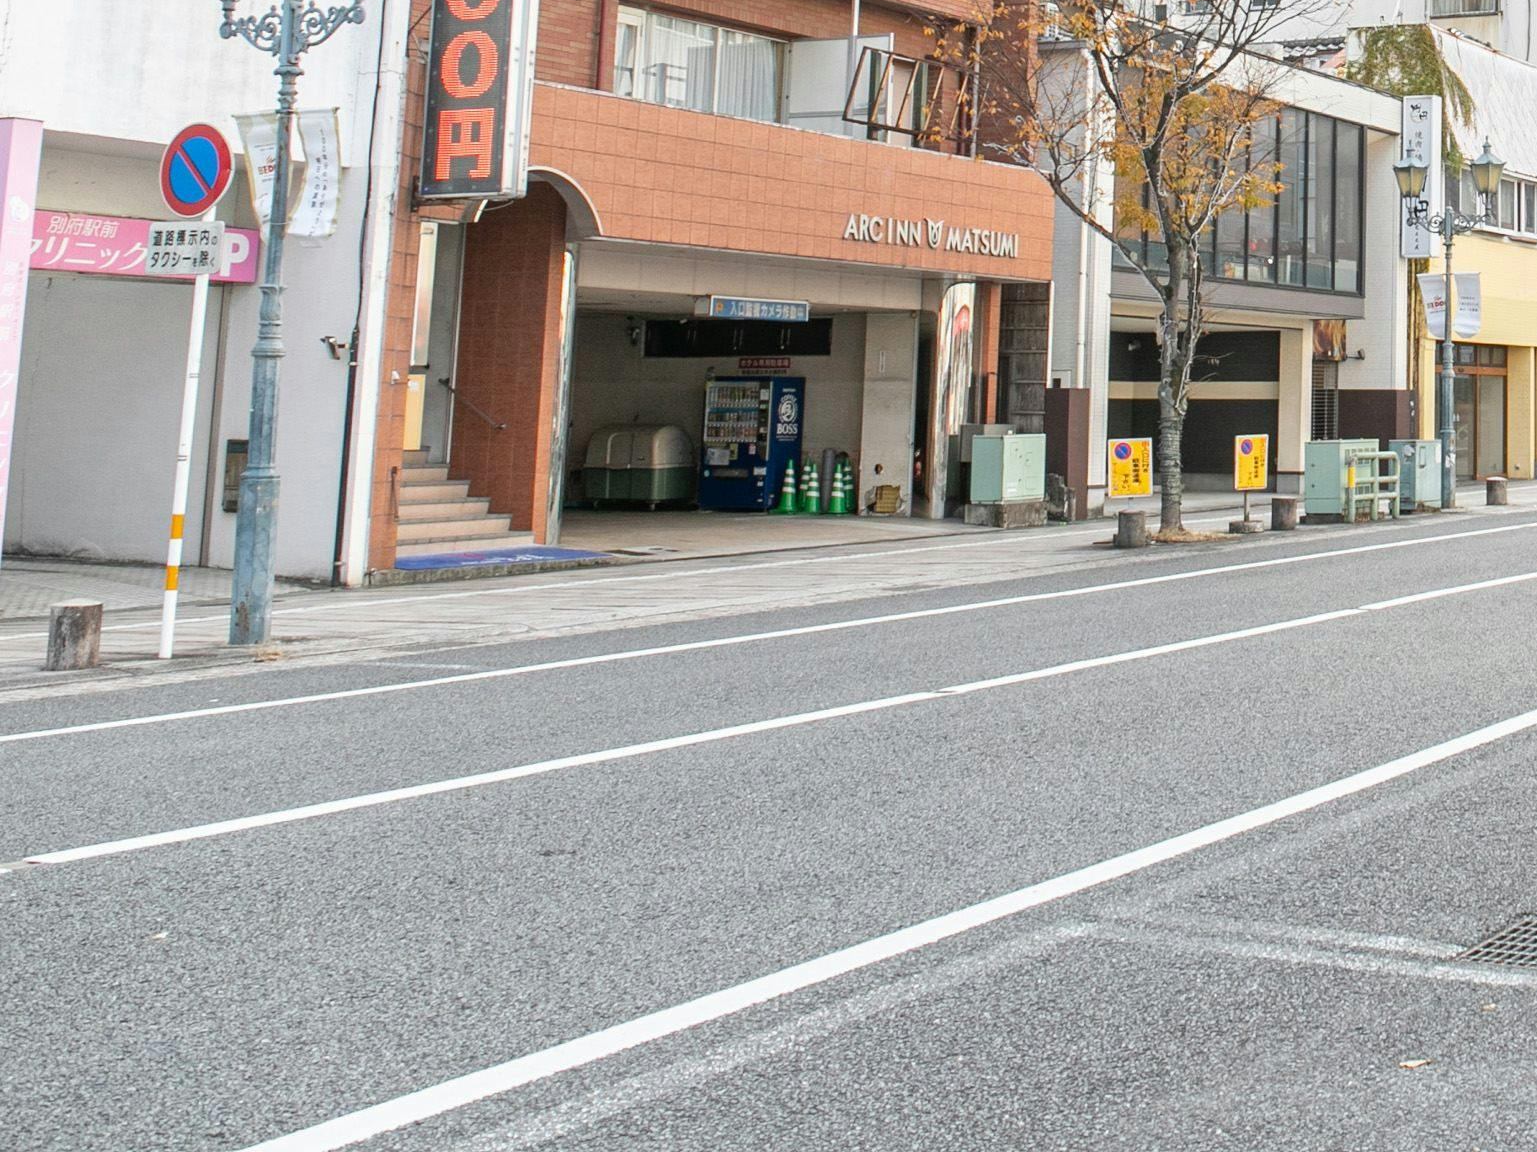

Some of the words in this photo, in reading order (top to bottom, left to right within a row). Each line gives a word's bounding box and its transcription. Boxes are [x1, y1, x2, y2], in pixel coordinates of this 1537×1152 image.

[46, 215, 121, 239] 別府駅前
[844, 214, 884, 242] ARC
[887, 217, 922, 246] INN
[945, 227, 1019, 258] MATSUMI
[152, 229, 218, 247] 道路標示内の
[150, 250, 217, 268] タクシーを除く
[219, 232, 250, 277] P
[776, 423, 799, 435] BOSS
